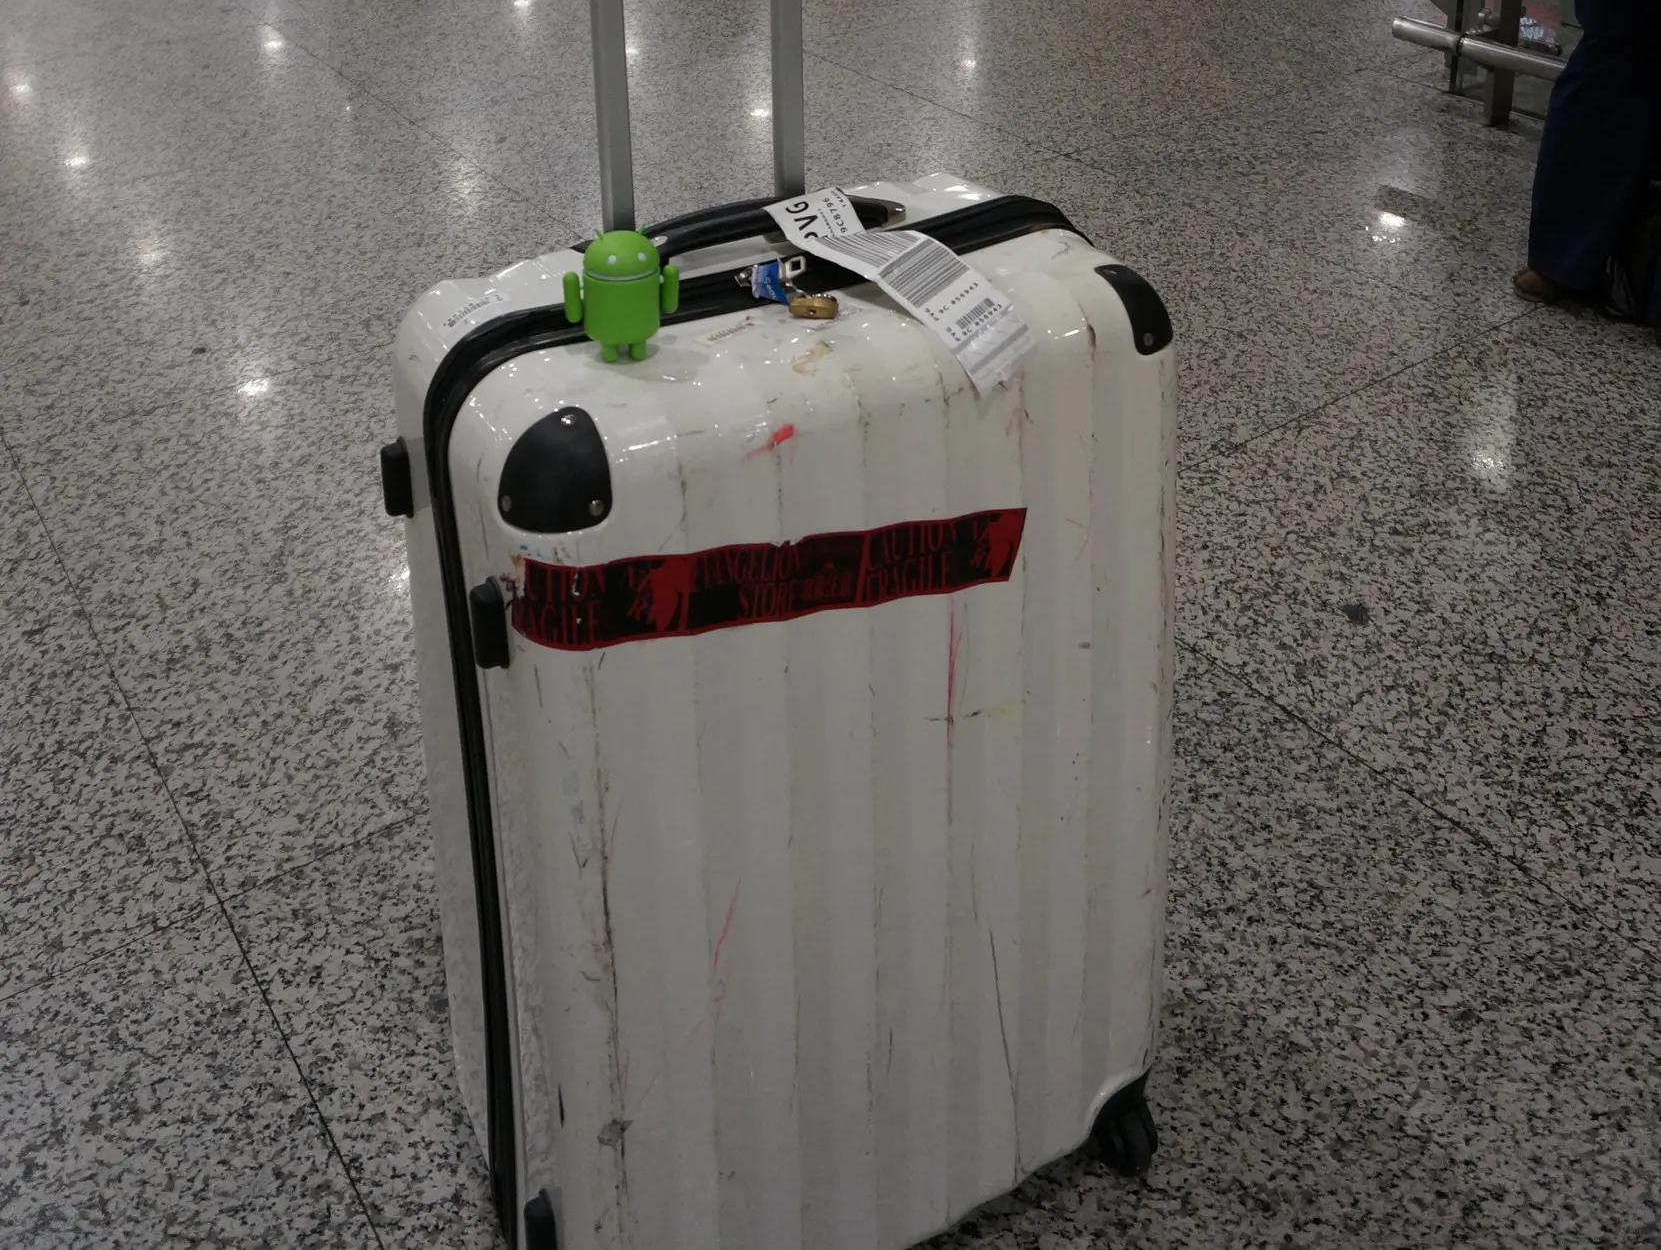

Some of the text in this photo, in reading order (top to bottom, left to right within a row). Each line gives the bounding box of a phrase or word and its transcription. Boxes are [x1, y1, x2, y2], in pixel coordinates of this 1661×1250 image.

[868, 520, 958, 572] CAUTION
[691, 548, 801, 594] EVANGELION
[865, 549, 953, 603] FRAGILE
[738, 579, 798, 618] STORE
